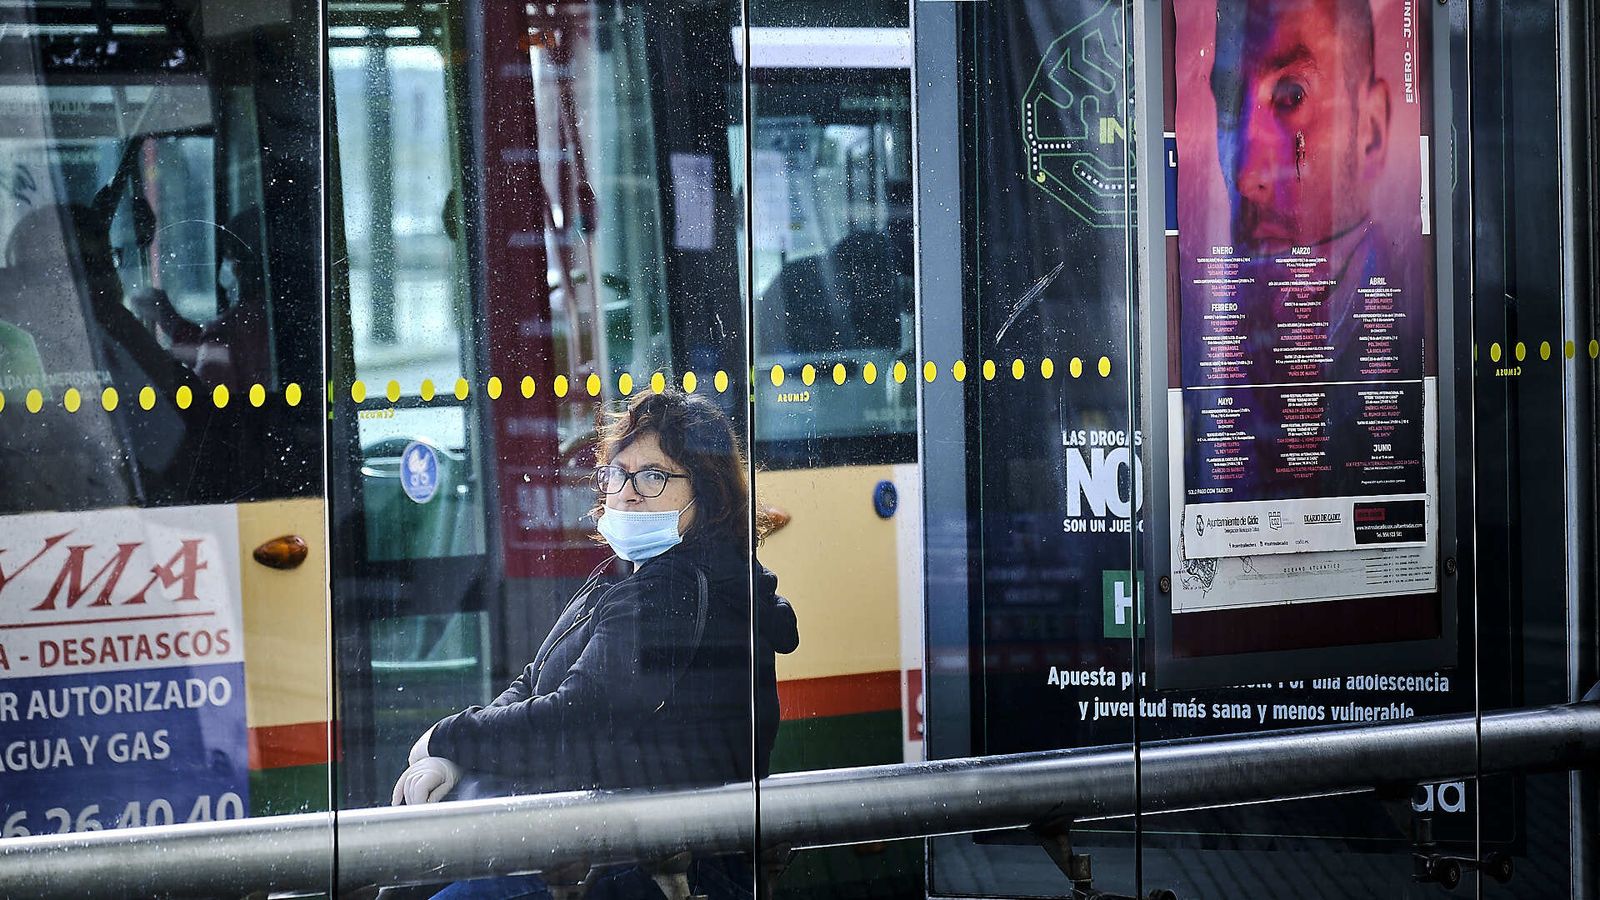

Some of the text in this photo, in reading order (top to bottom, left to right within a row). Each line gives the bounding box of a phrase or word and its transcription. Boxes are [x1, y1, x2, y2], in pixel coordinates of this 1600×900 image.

[1405, 52, 1413, 103] ENERO
[1212, 247, 1233, 255] ENERO
[1292, 247, 1311, 255] MARZO
[1212, 304, 1238, 312] FEBRERO
[1218, 398, 1233, 406] MAYO
[1062, 430, 1087, 446] LAS
[1373, 444, 1392, 452] JUNIO
[1066, 447, 1144, 518] NO
[1063, 519, 1087, 533] SON
[1090, 519, 1106, 533] UN
[1206, 516, 1240, 529] Ayuntamiento
[1240, 517, 1247, 525] de
[1304, 514, 1321, 523] DIARIO
[1321, 514, 1328, 522] DE
[39, 629, 231, 668] DESATASCOS
[1048, 666, 1116, 690] Apuesta
[1346, 672, 1450, 692] adolescencia
[0, 676, 232, 722] R AUTORIZADO
[1078, 701, 1089, 721] y
[1172, 698, 1207, 719] más
[1212, 703, 1252, 719] sana
[1257, 704, 1268, 724] y
[1273, 703, 1326, 721] menos
[1331, 702, 1415, 722] vulnerable
[79, 735, 100, 765] Y
[107, 729, 171, 763] GAS
[187, 792, 244, 824] 40
